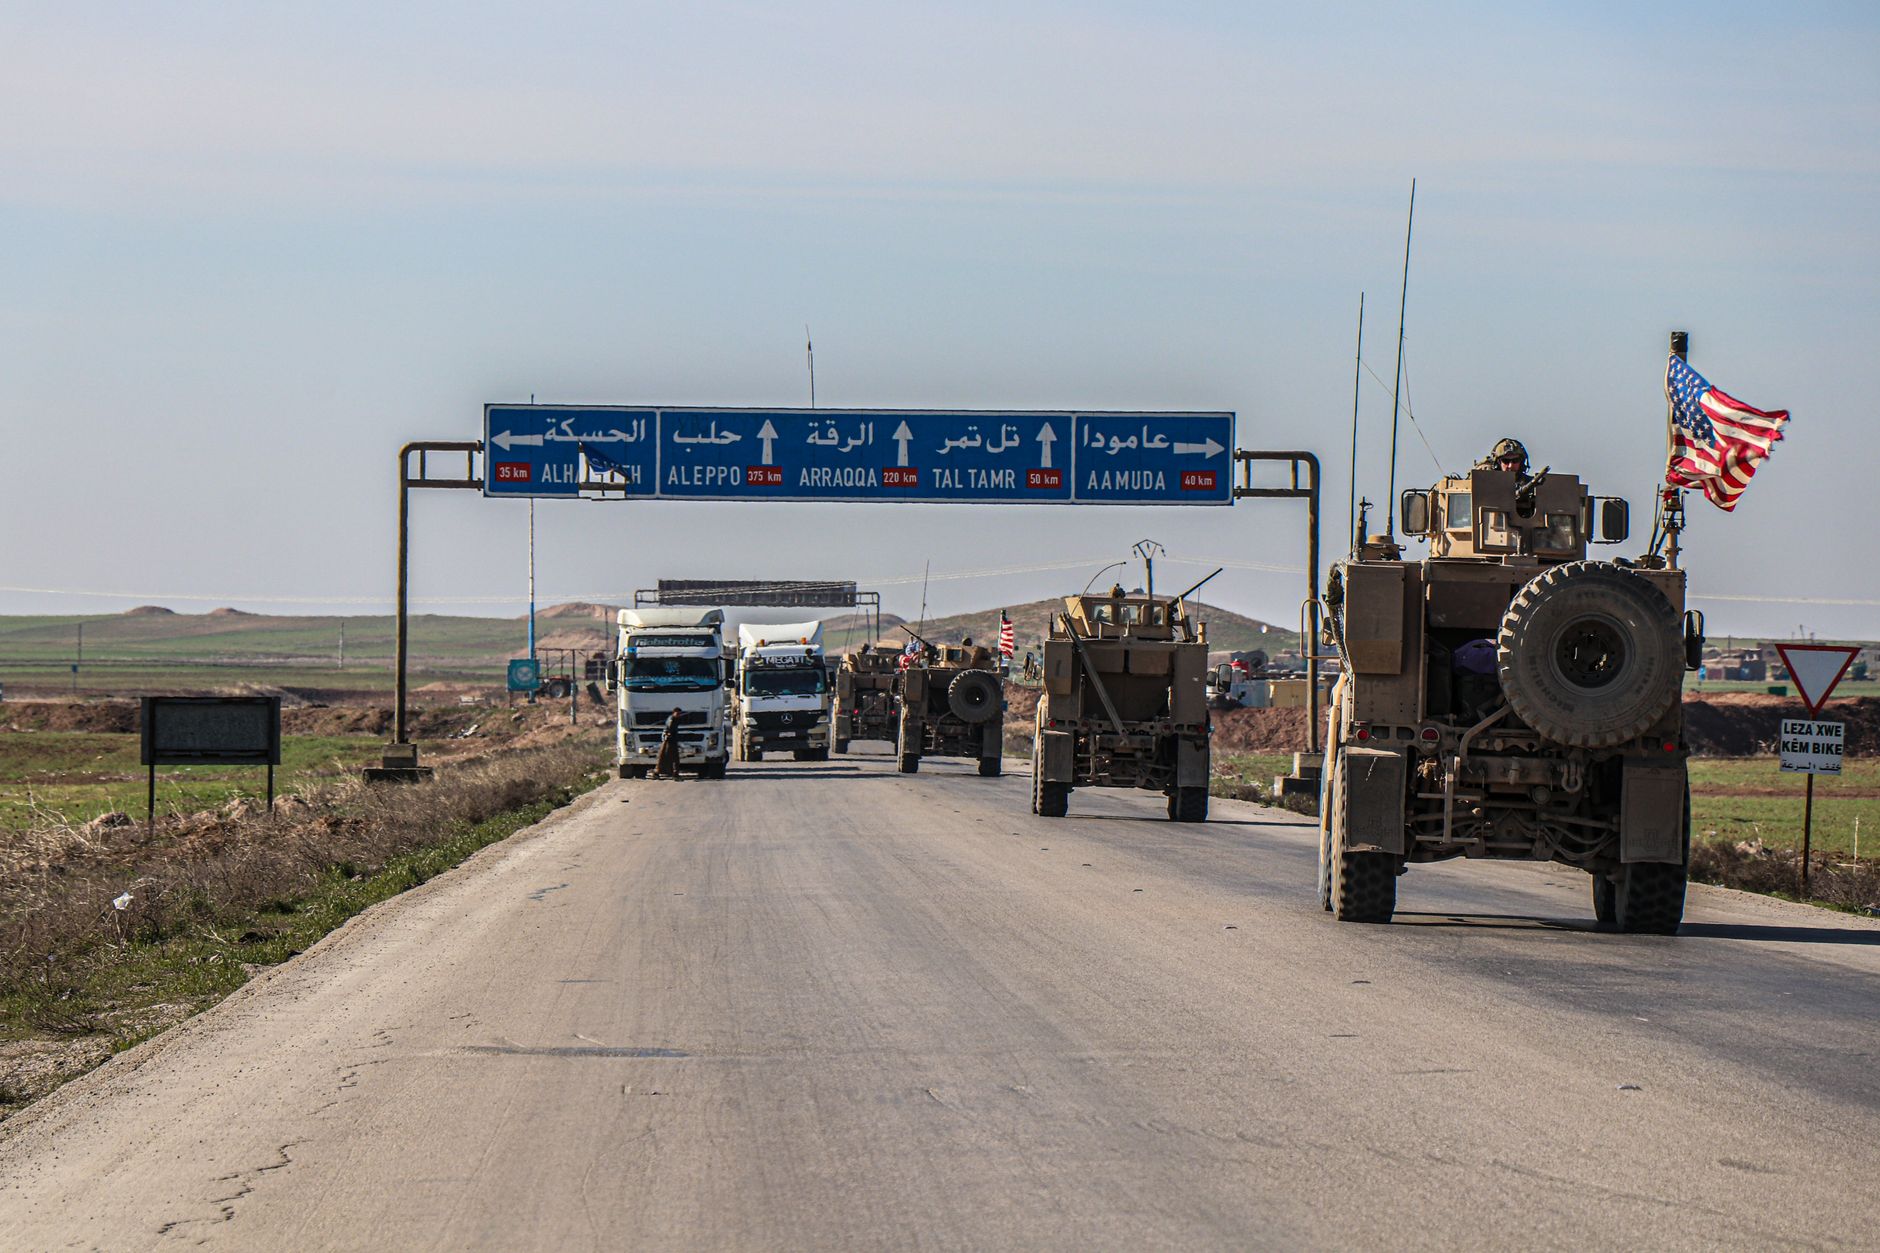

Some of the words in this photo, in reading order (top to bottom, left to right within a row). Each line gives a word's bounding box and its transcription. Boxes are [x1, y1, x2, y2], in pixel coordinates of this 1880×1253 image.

[543, 417, 646, 442] الحسكة
[672, 420, 742, 453] حلب
[806, 419, 874, 453] الرقة
[935, 425, 982, 455] تمر
[986, 423, 1020, 453] تل
[1083, 423, 1170, 455] عامودا
[499, 466, 511, 478] 35
[513, 466, 528, 478] km
[667, 465, 741, 486] ALEPPO
[748, 471, 763, 482] 375
[767, 471, 782, 482] km
[799, 467, 878, 487] ARRAQQA
[883, 472, 899, 483] 220
[903, 472, 917, 483] km
[932, 468, 963, 488] TAL
[967, 469, 1016, 489] TAMR
[1030, 473, 1040, 484] 50
[1044, 474, 1058, 485] km
[1087, 470, 1166, 491] AAMUDA
[1184, 475, 1196, 486] 40
[1198, 475, 1213, 486] km
[1784, 722, 1813, 736] LEZA
[1816, 724, 1842, 737] XWE
[1782, 738, 1809, 753] KÊM
[1812, 742, 1842, 755] BIKE
